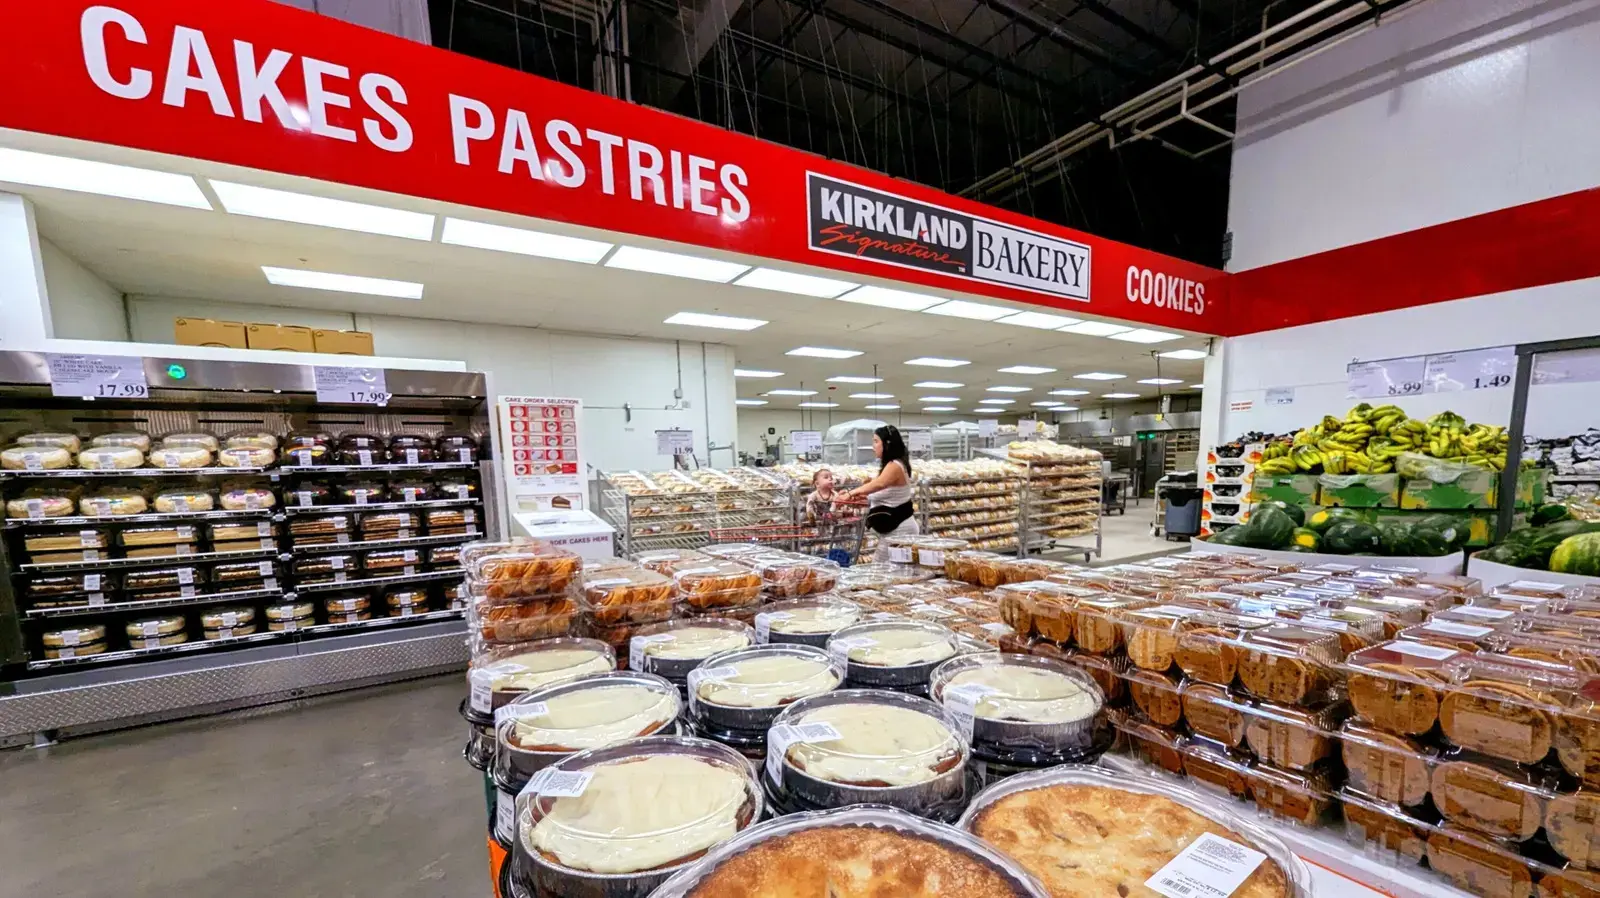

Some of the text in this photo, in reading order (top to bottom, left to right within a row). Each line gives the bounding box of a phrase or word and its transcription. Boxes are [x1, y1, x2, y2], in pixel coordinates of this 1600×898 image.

[80, 6, 751, 224] CAKES PASTRIES
[820, 187, 967, 250] KIRKLAND
[819, 224, 966, 266] Signature
[976, 229, 1085, 288] BAKERY
[1126, 265, 1206, 316] COOKIES
[98, 384, 145, 397] 17.99
[350, 391, 385, 402] 17.99
[1388, 382, 1421, 395] 8.99
[1473, 375, 1511, 389] 1.49
